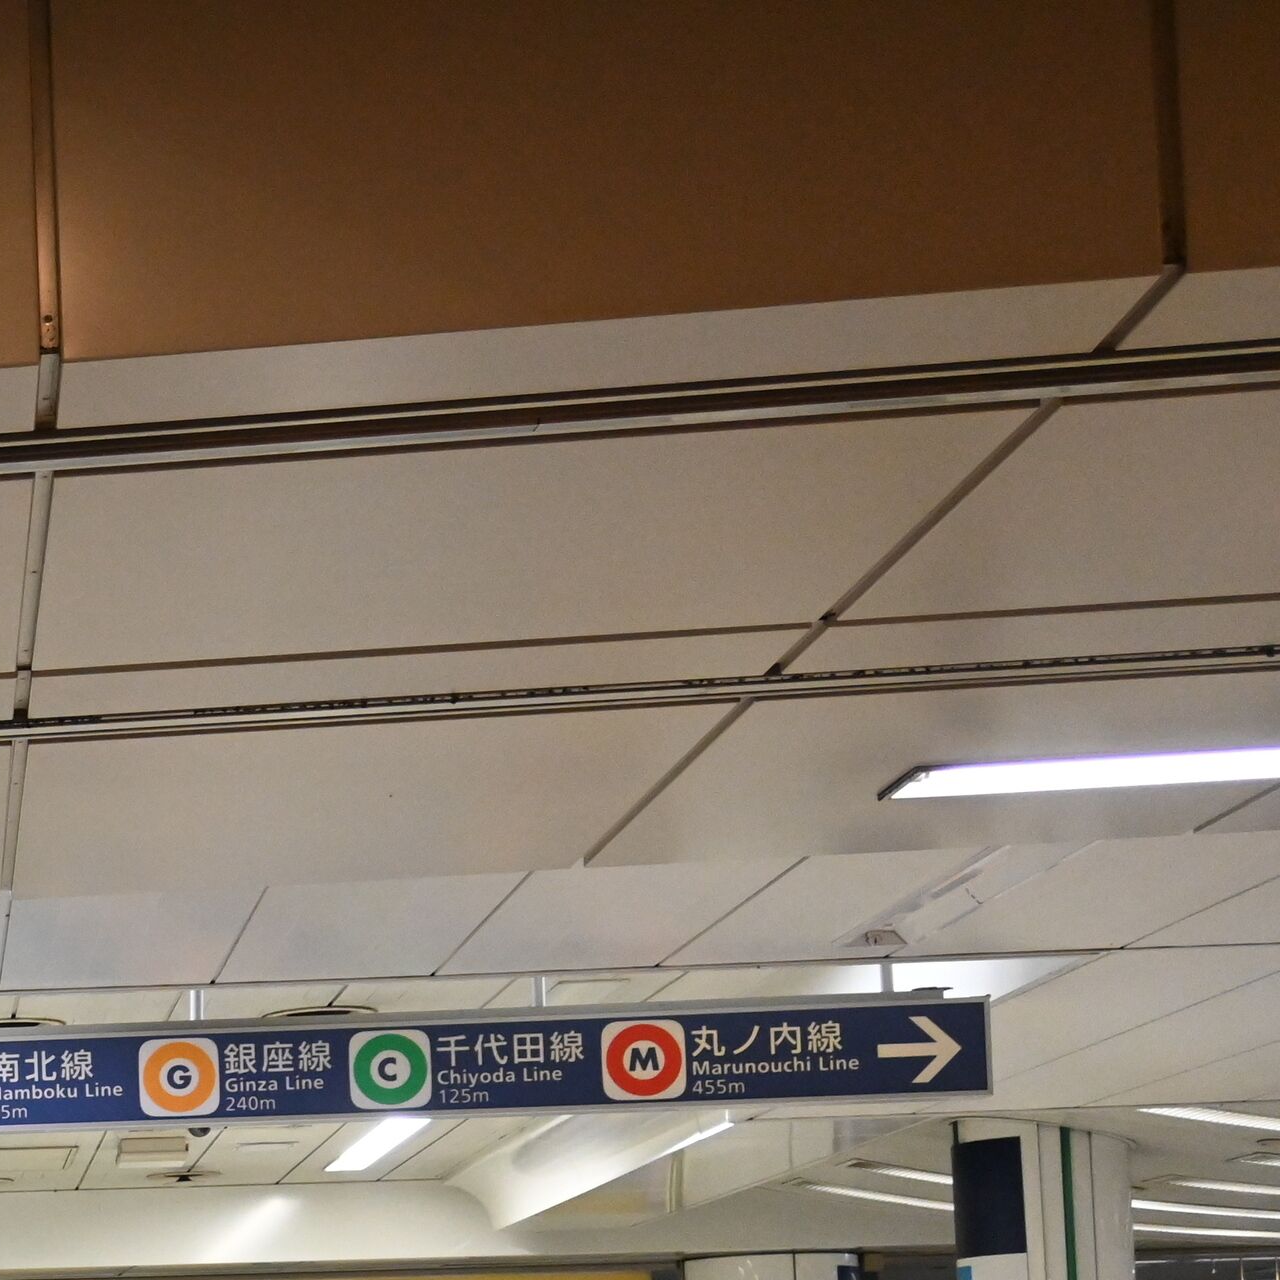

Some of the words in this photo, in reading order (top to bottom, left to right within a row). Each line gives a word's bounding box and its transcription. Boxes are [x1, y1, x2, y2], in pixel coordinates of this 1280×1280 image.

[436, 1030, 585, 1067] 千代田線
[691, 1020, 843, 1057] 丸ノ内線
[224, 1040, 332, 1075] 銀座線
[629, 1047, 660, 1072] M
[692, 1056, 811, 1076] Marunouchi
[819, 1054, 860, 1071] Line
[166, 1064, 192, 1089] G
[377, 1057, 398, 1082] C
[437, 1068, 516, 1089] Chiyoda
[523, 1066, 563, 1082] Line
[85, 1082, 124, 1098] Line
[225, 1076, 279, 1093] Ginza
[285, 1074, 325, 1091] Line
[692, 1079, 746, 1095] 455m
[225, 1096, 276, 1112] 240m
[439, 1088, 490, 1104] 125m
